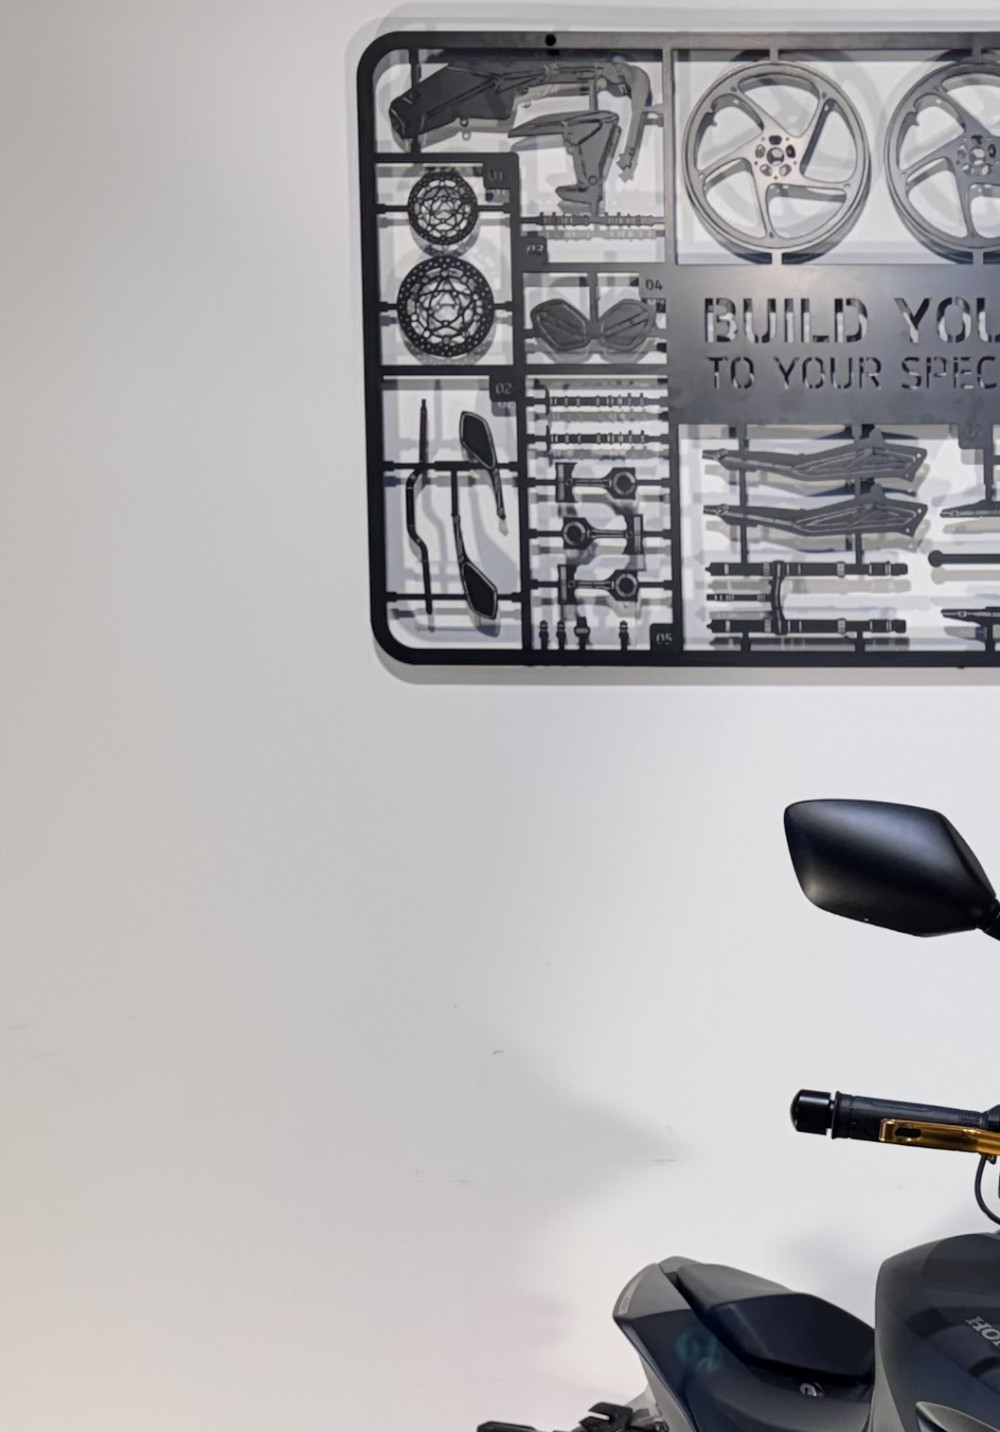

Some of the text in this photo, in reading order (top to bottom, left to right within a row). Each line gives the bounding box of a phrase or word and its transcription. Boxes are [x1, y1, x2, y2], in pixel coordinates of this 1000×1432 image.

[645, 279, 662, 291] 04
[704, 297, 869, 343] BUILD
[705, 356, 755, 390] TO
[773, 356, 882, 390] YOUR
[495, 382, 512, 395] 02
